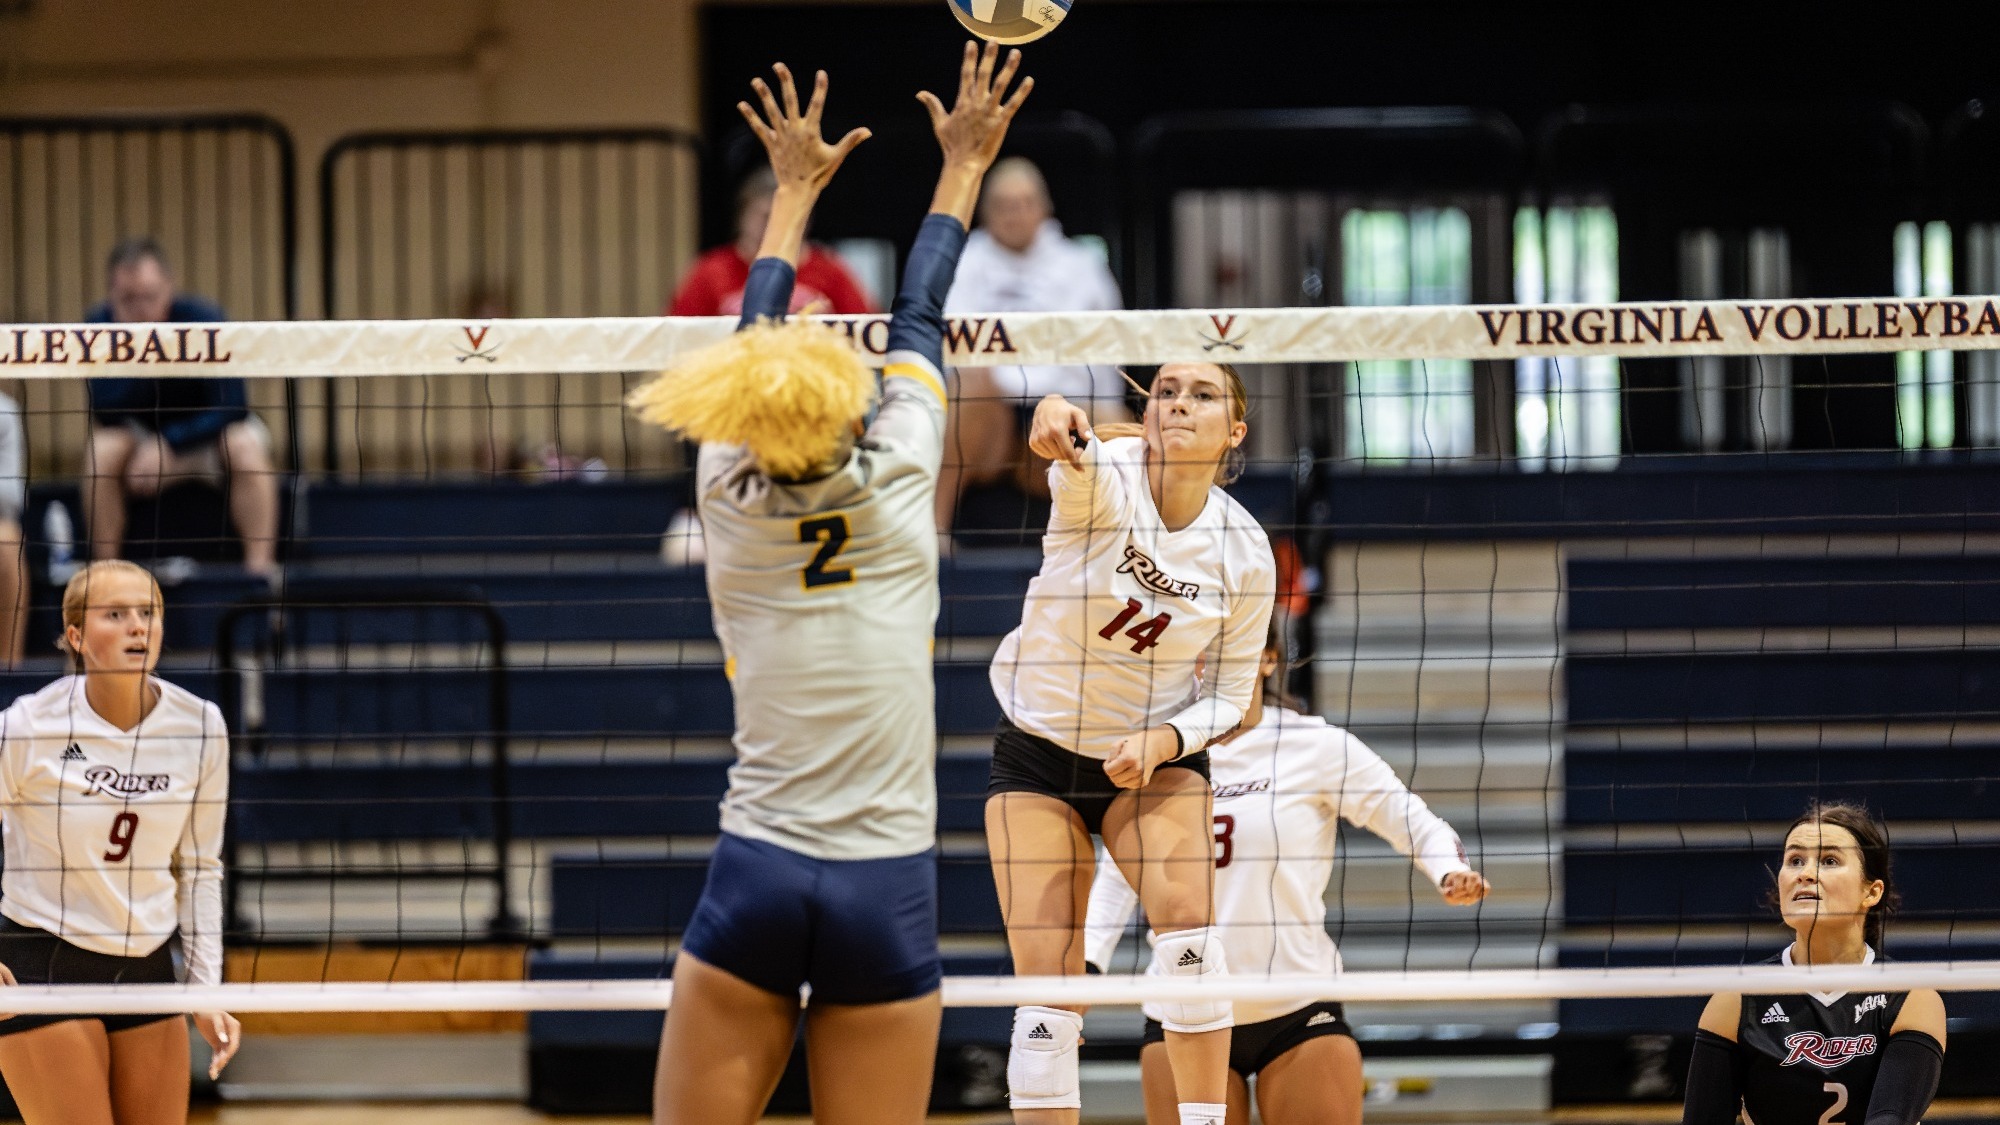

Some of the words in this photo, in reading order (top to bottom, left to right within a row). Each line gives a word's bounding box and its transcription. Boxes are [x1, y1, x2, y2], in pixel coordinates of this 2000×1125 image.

[462, 325, 490, 351] V
[1209, 313, 1238, 339] V
[1476, 305, 1724, 346] VIRGINIA
[1737, 299, 2000, 342] VOLLEYBA
[798, 512, 854, 589] 2
[1116, 545, 1200, 601] RIDER
[1098, 596, 1172, 655] 14
[81, 765, 170, 799] RIDER
[1211, 778, 1271, 803] IDER
[103, 812, 139, 863] 9
[1177, 957, 1203, 967] adidas
[1028, 1032, 1053, 1040] adidas
[1761, 1013, 1790, 1024] adidas
[1779, 1031, 1878, 1068] RIDER
[1818, 1081, 1849, 1125] 2
